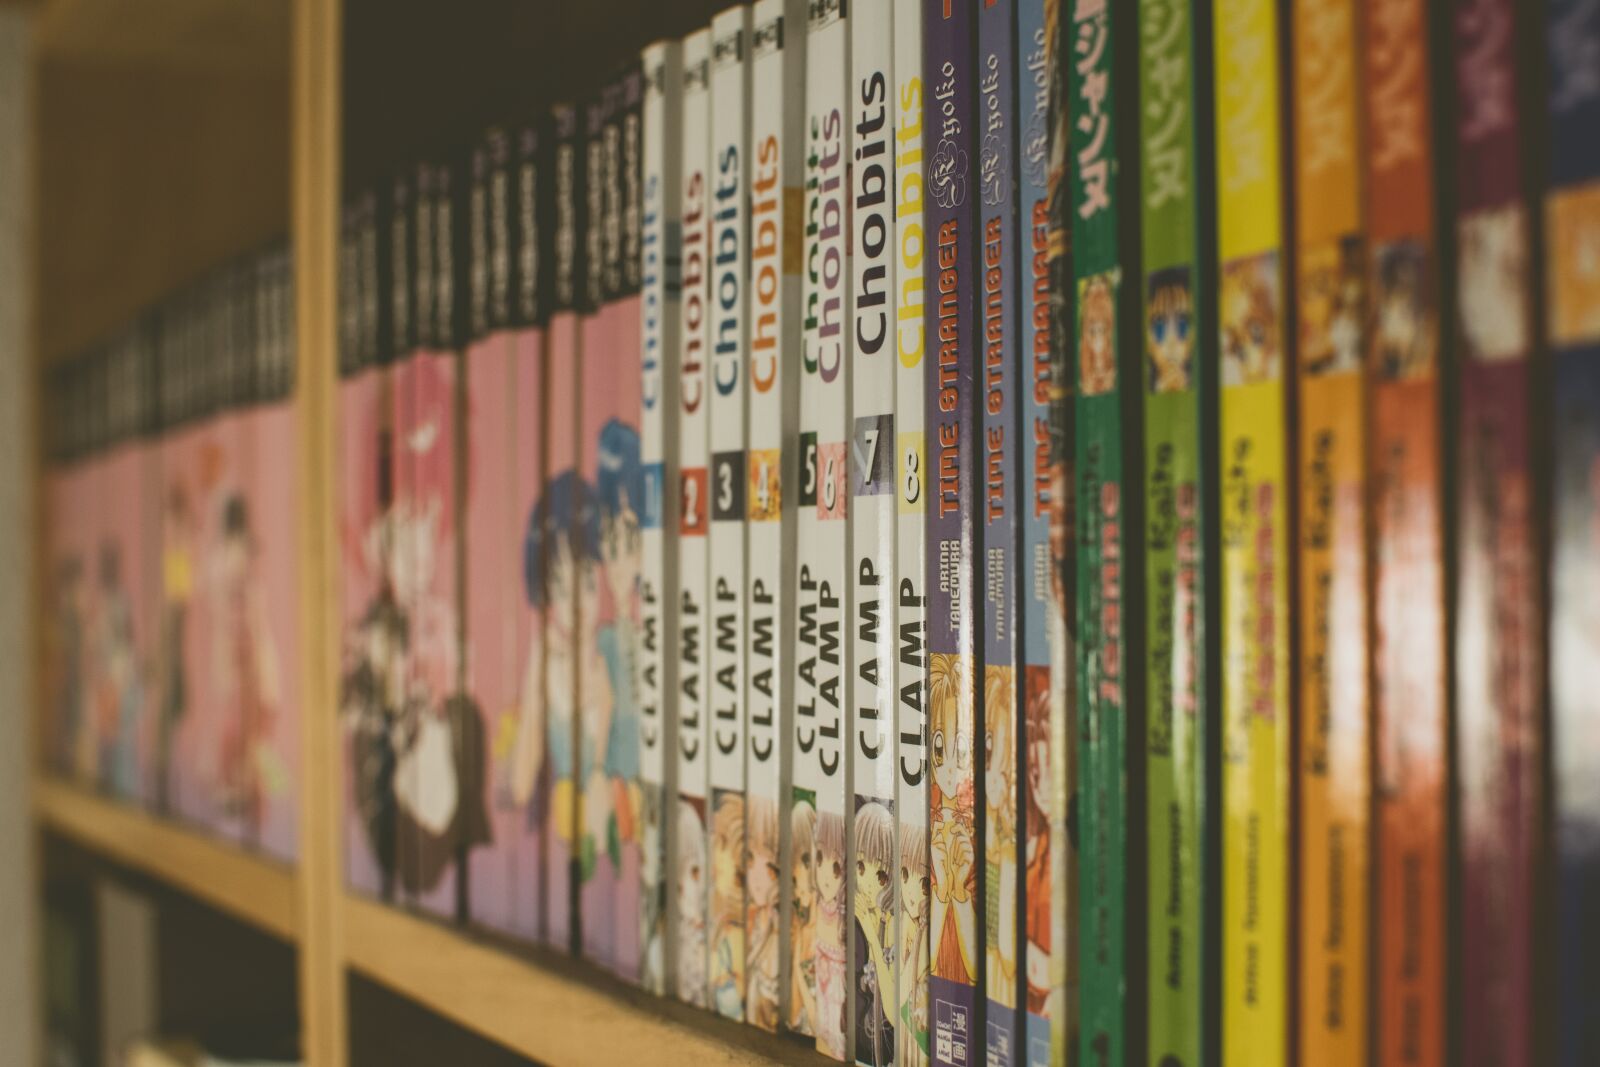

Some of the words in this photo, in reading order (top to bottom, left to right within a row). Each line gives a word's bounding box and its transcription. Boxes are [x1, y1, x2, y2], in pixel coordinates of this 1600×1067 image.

[856, 71, 886, 355] Chobits
[929, 61, 968, 208] Kyoko
[682, 171, 703, 414] Chobits
[715, 145, 737, 396] Chobits
[752, 135, 777, 393] Chobits
[819, 109, 840, 383] Chobits
[896, 76, 925, 368] Chobits
[1032, 198, 1051, 406] STRANGER
[939, 218, 959, 412] STRANGER
[985, 216, 1003, 415] STRANGER
[718, 462, 733, 511] 3
[755, 460, 769, 511] 4
[805, 445, 817, 495] 5
[823, 459, 836, 512] 6
[864, 430, 879, 486] 7
[904, 448, 919, 504] 8
[939, 423, 960, 519] TIME
[987, 424, 1004, 526] TIME
[1034, 417, 1052, 521] TIME
[939, 540, 949, 592] ARINA
[950, 540, 960, 632] TANEMURA
[988, 548, 997, 602] ARINA
[996, 548, 1004, 642] TANEMURA
[681, 590, 698, 761] CLAMP
[716, 576, 736, 755] CLAMP
[752, 578, 772, 761] CLAMP
[797, 564, 817, 753] CLAMP
[819, 580, 839, 776] CLAMP
[899, 577, 927, 786] CLAMP
